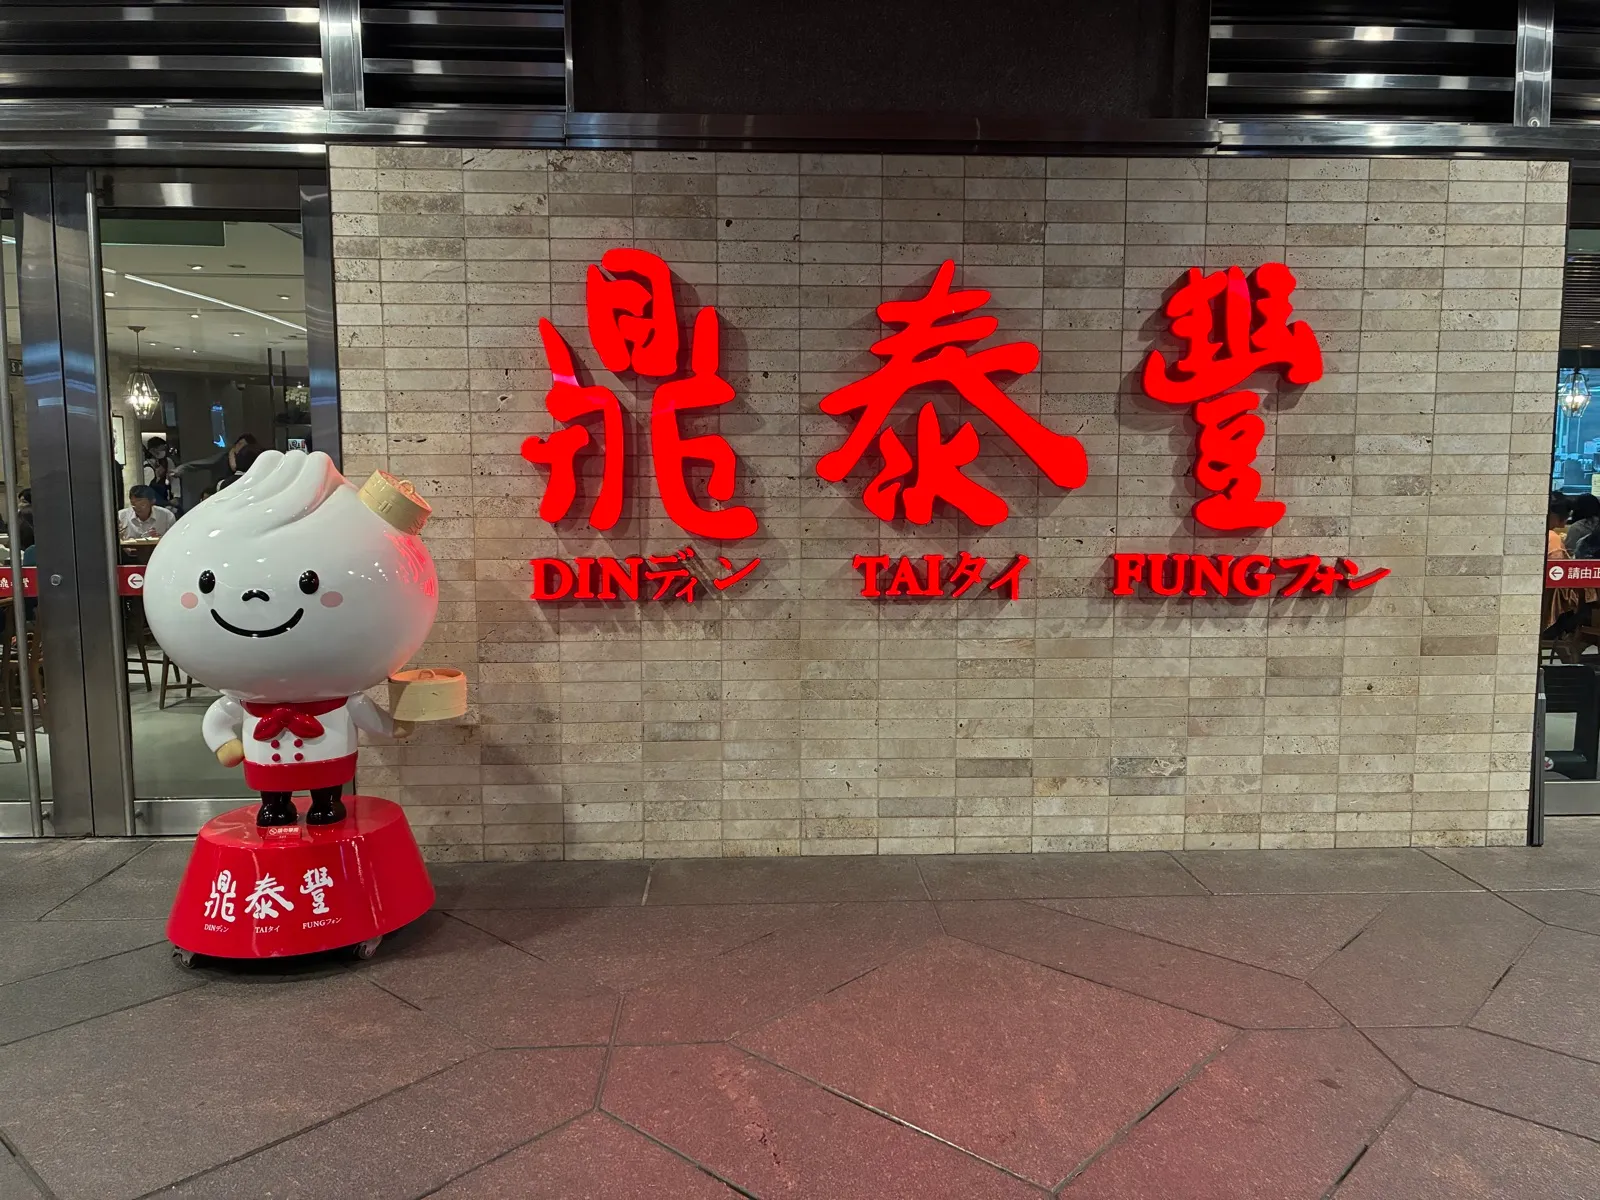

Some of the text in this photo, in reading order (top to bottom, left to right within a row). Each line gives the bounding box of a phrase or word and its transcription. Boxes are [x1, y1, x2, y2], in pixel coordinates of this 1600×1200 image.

[521, 247, 1324, 539] 鼎泰豐
[530, 547, 1392, 603] DINディン TAIタイ FUNGフォン
[203, 866, 334, 923] 鼎泰豐
